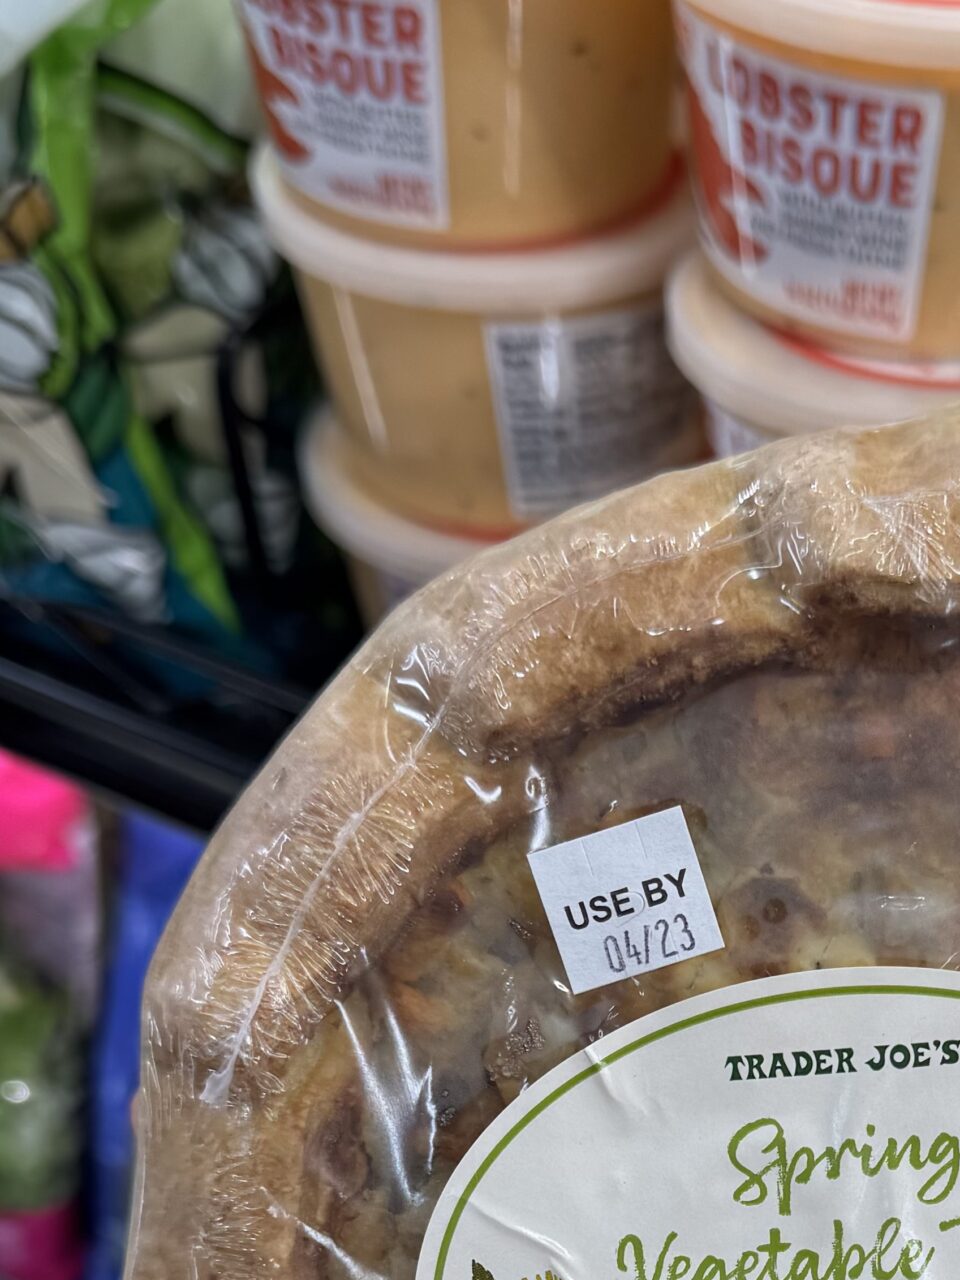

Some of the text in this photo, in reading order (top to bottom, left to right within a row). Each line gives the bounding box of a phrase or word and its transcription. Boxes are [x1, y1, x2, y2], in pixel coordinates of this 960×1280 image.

[704, 38, 924, 154] LOBSTER
[738, 120, 918, 208] BISQUE
[564, 867, 687, 931] USE BY
[603, 913, 696, 973] 04/23
[724, 1047, 858, 1081] TRADER
